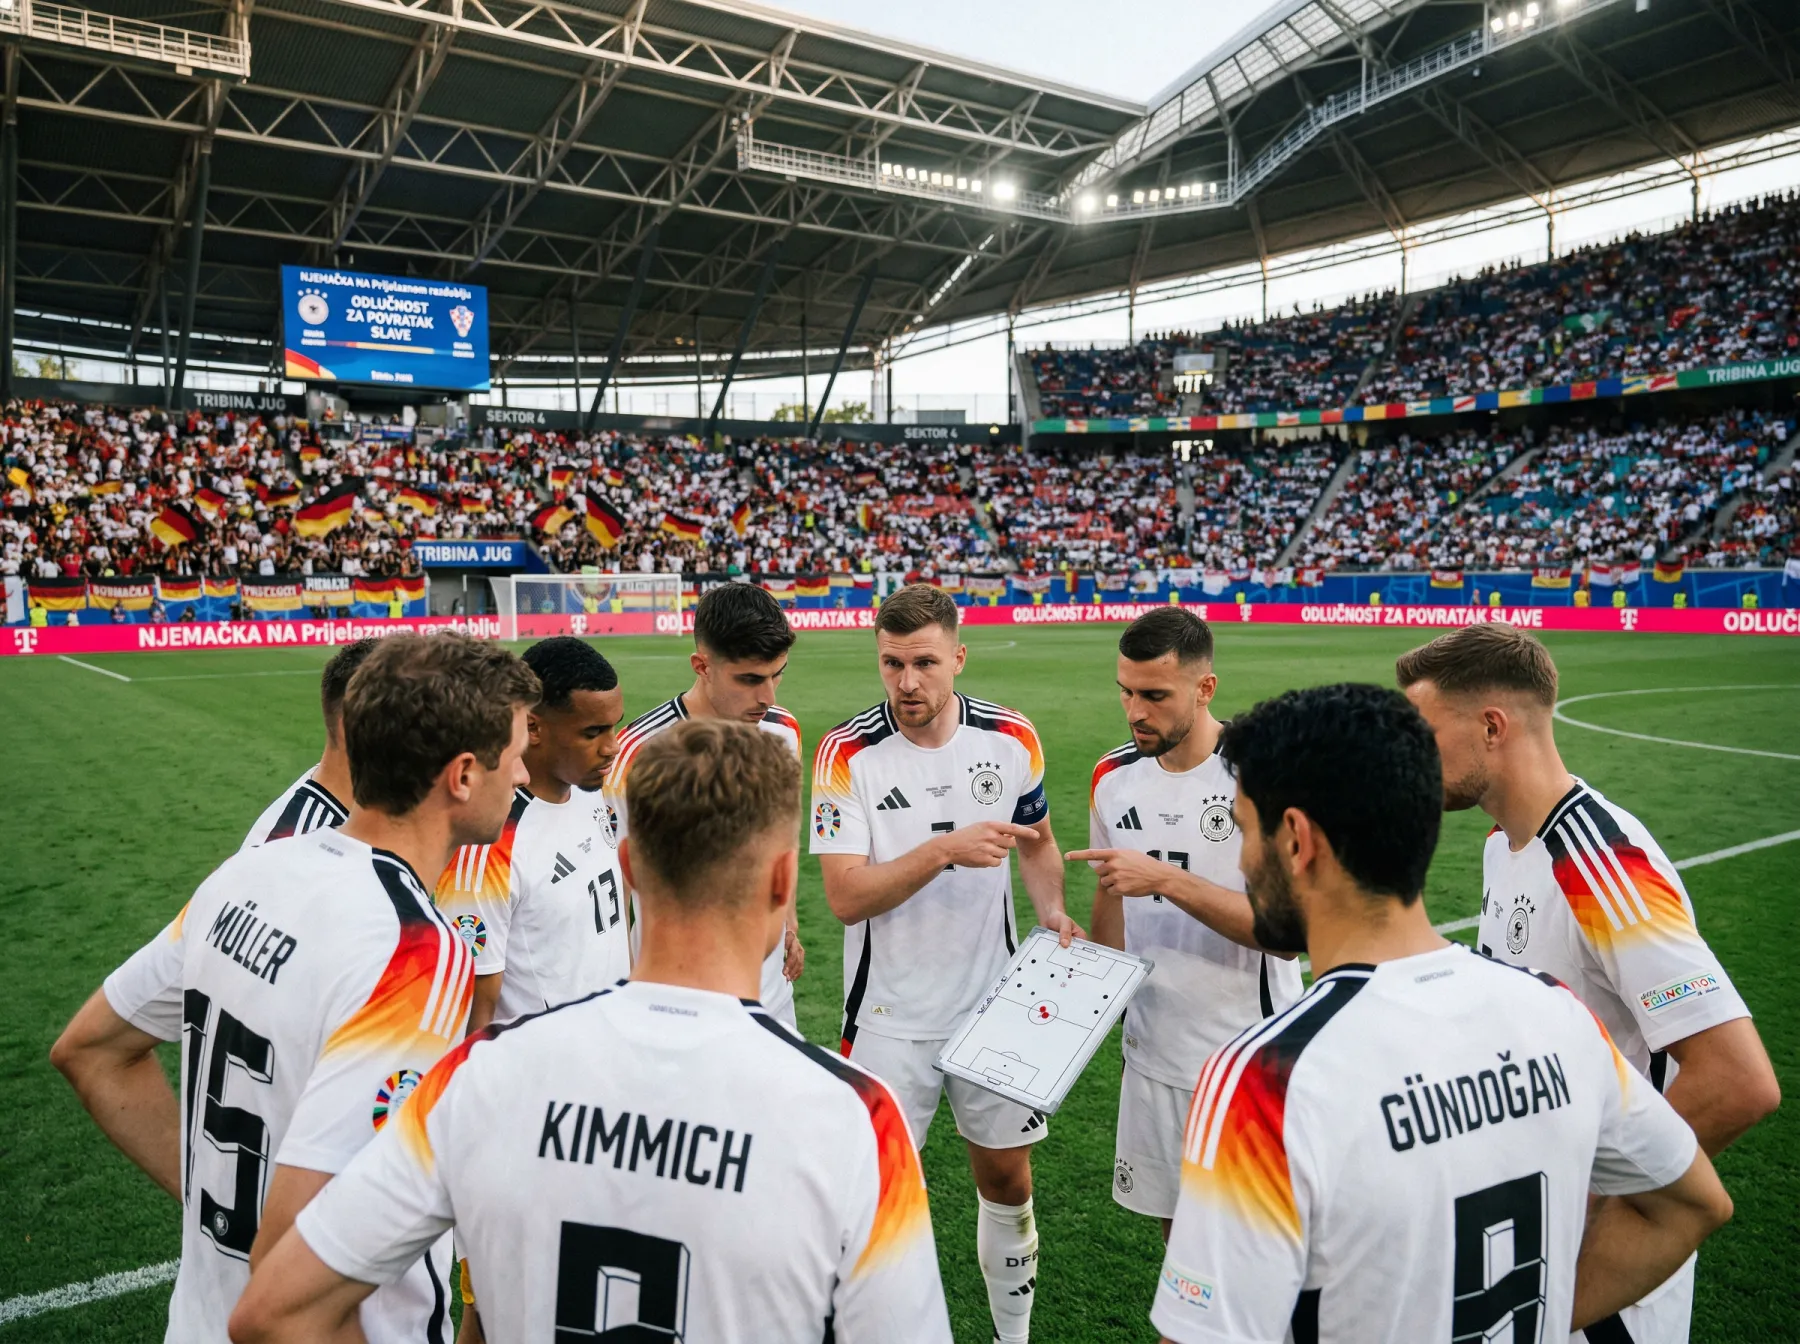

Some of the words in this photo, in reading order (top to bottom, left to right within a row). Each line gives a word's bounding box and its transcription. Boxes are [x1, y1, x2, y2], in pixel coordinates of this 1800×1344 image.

[355, 277, 371, 289] NA
[351, 295, 430, 314] ODLUČNOST
[346, 308, 364, 323] ZA
[366, 310, 434, 329] POVRATAK
[370, 325, 412, 341] SLAVE
[1707, 363, 1767, 383] TRIBINA
[1770, 359, 1800, 376] JUG
[194, 392, 255, 409] TRIBINA
[258, 397, 286, 411] JUG
[486, 409, 535, 424] SEKTOR
[537, 412, 546, 424] 4
[904, 427, 948, 439] SEKTOR
[950, 427, 958, 439] 4
[414, 546, 479, 561] TRIBINA
[482, 546, 512, 561] JUG
[1012, 603, 1083, 622] ODLUČNOST
[1086, 605, 1100, 620] ZA
[1103, 604, 1166, 620] POVRAT
[1301, 603, 1382, 623] ODLUČNOST
[1384, 607, 1402, 623] ZA
[1406, 607, 1488, 625] POVRATAK
[1490, 608, 1543, 627] SLAVE
[1723, 608, 1800, 633] ODLUČ
[138, 621, 262, 647] NJEMAČKA
[267, 624, 298, 643] NA
[587, 868, 620, 935] 13
[205, 899, 298, 985] MÜLLER
[1380, 1050, 1571, 1152] GÜNDOĞAN
[183, 988, 275, 1263] 15
[538, 1101, 752, 1193] KIMMICH
